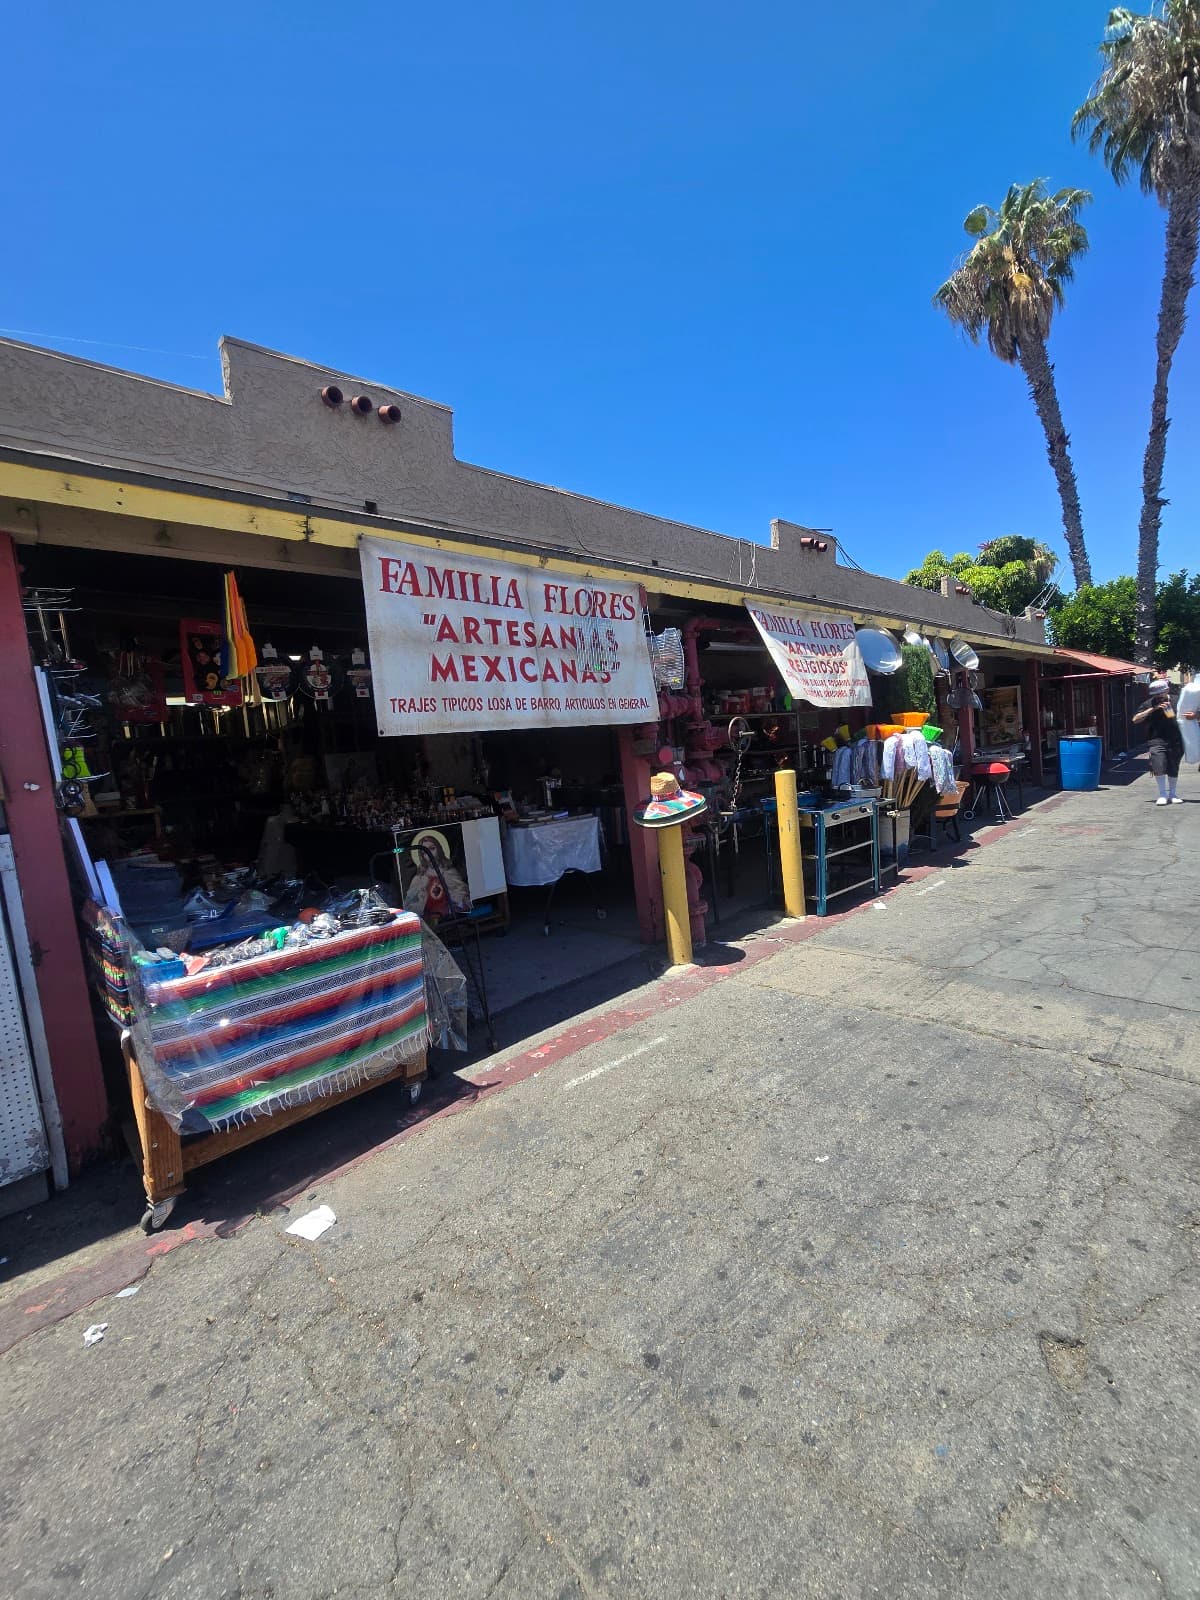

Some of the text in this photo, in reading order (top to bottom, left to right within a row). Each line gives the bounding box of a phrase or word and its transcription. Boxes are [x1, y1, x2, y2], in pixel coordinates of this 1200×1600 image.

[378, 556, 636, 621] FAMILIA FLORES
[752, 609, 856, 640] FAMILIA FLORES
[390, 697, 651, 713] TRAJES TIPICOS LOSA DE BARRO, ARTICULOS EN GENERAL
